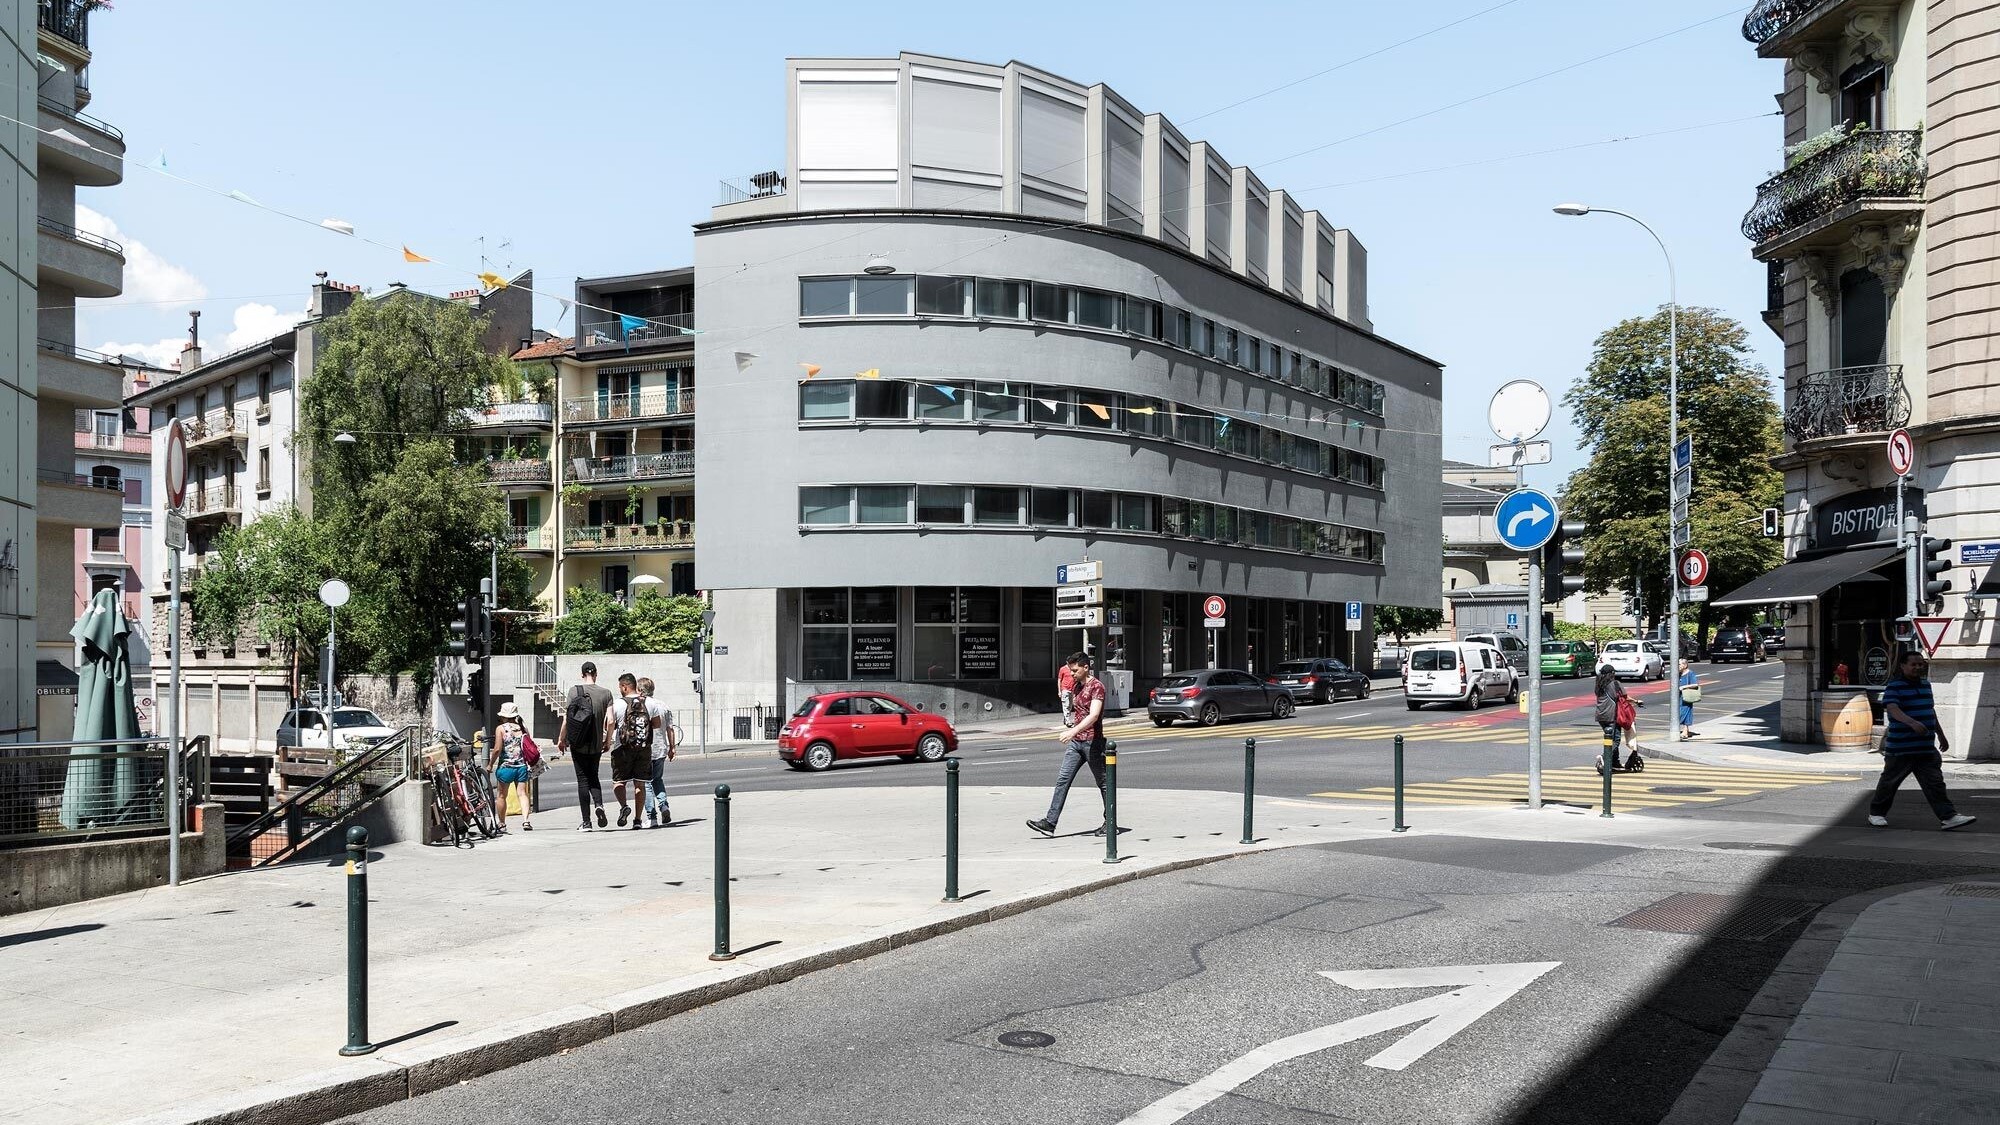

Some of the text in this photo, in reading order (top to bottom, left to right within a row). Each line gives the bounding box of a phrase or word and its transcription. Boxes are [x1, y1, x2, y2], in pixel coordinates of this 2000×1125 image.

[1832, 505, 1886, 535] BISTRO
[1686, 563, 1699, 574] 30
[1351, 604, 1356, 612] P
